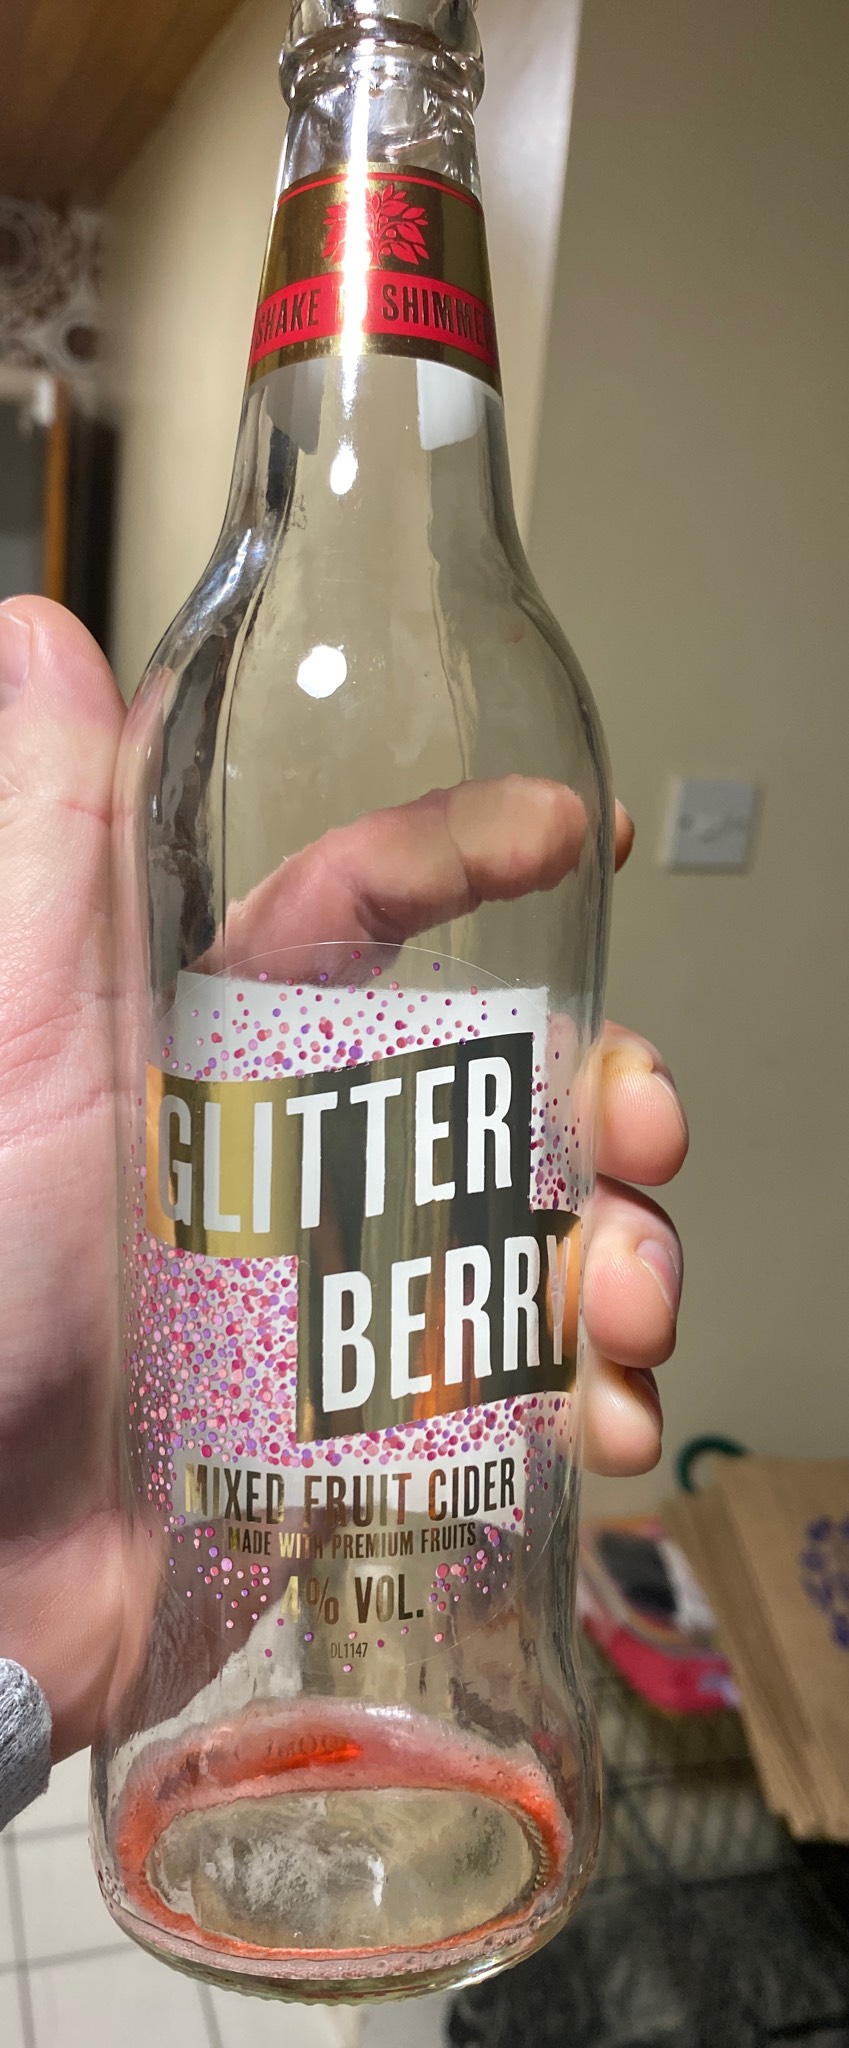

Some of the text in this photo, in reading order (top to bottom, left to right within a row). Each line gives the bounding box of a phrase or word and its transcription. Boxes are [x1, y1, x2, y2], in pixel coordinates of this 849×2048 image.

[255, 288, 321, 350] SHAKE
[157, 1055, 513, 1234] GLITTER
[321, 1234, 571, 1413] BERRY
[184, 1457, 515, 1528] MIXED FRUIT CIDER
[228, 1521, 477, 1560] MADE WITH PREMIUM FRUITS
[279, 1573, 424, 1625] 4% VOL.
[330, 1642, 369, 1659] DL1147
